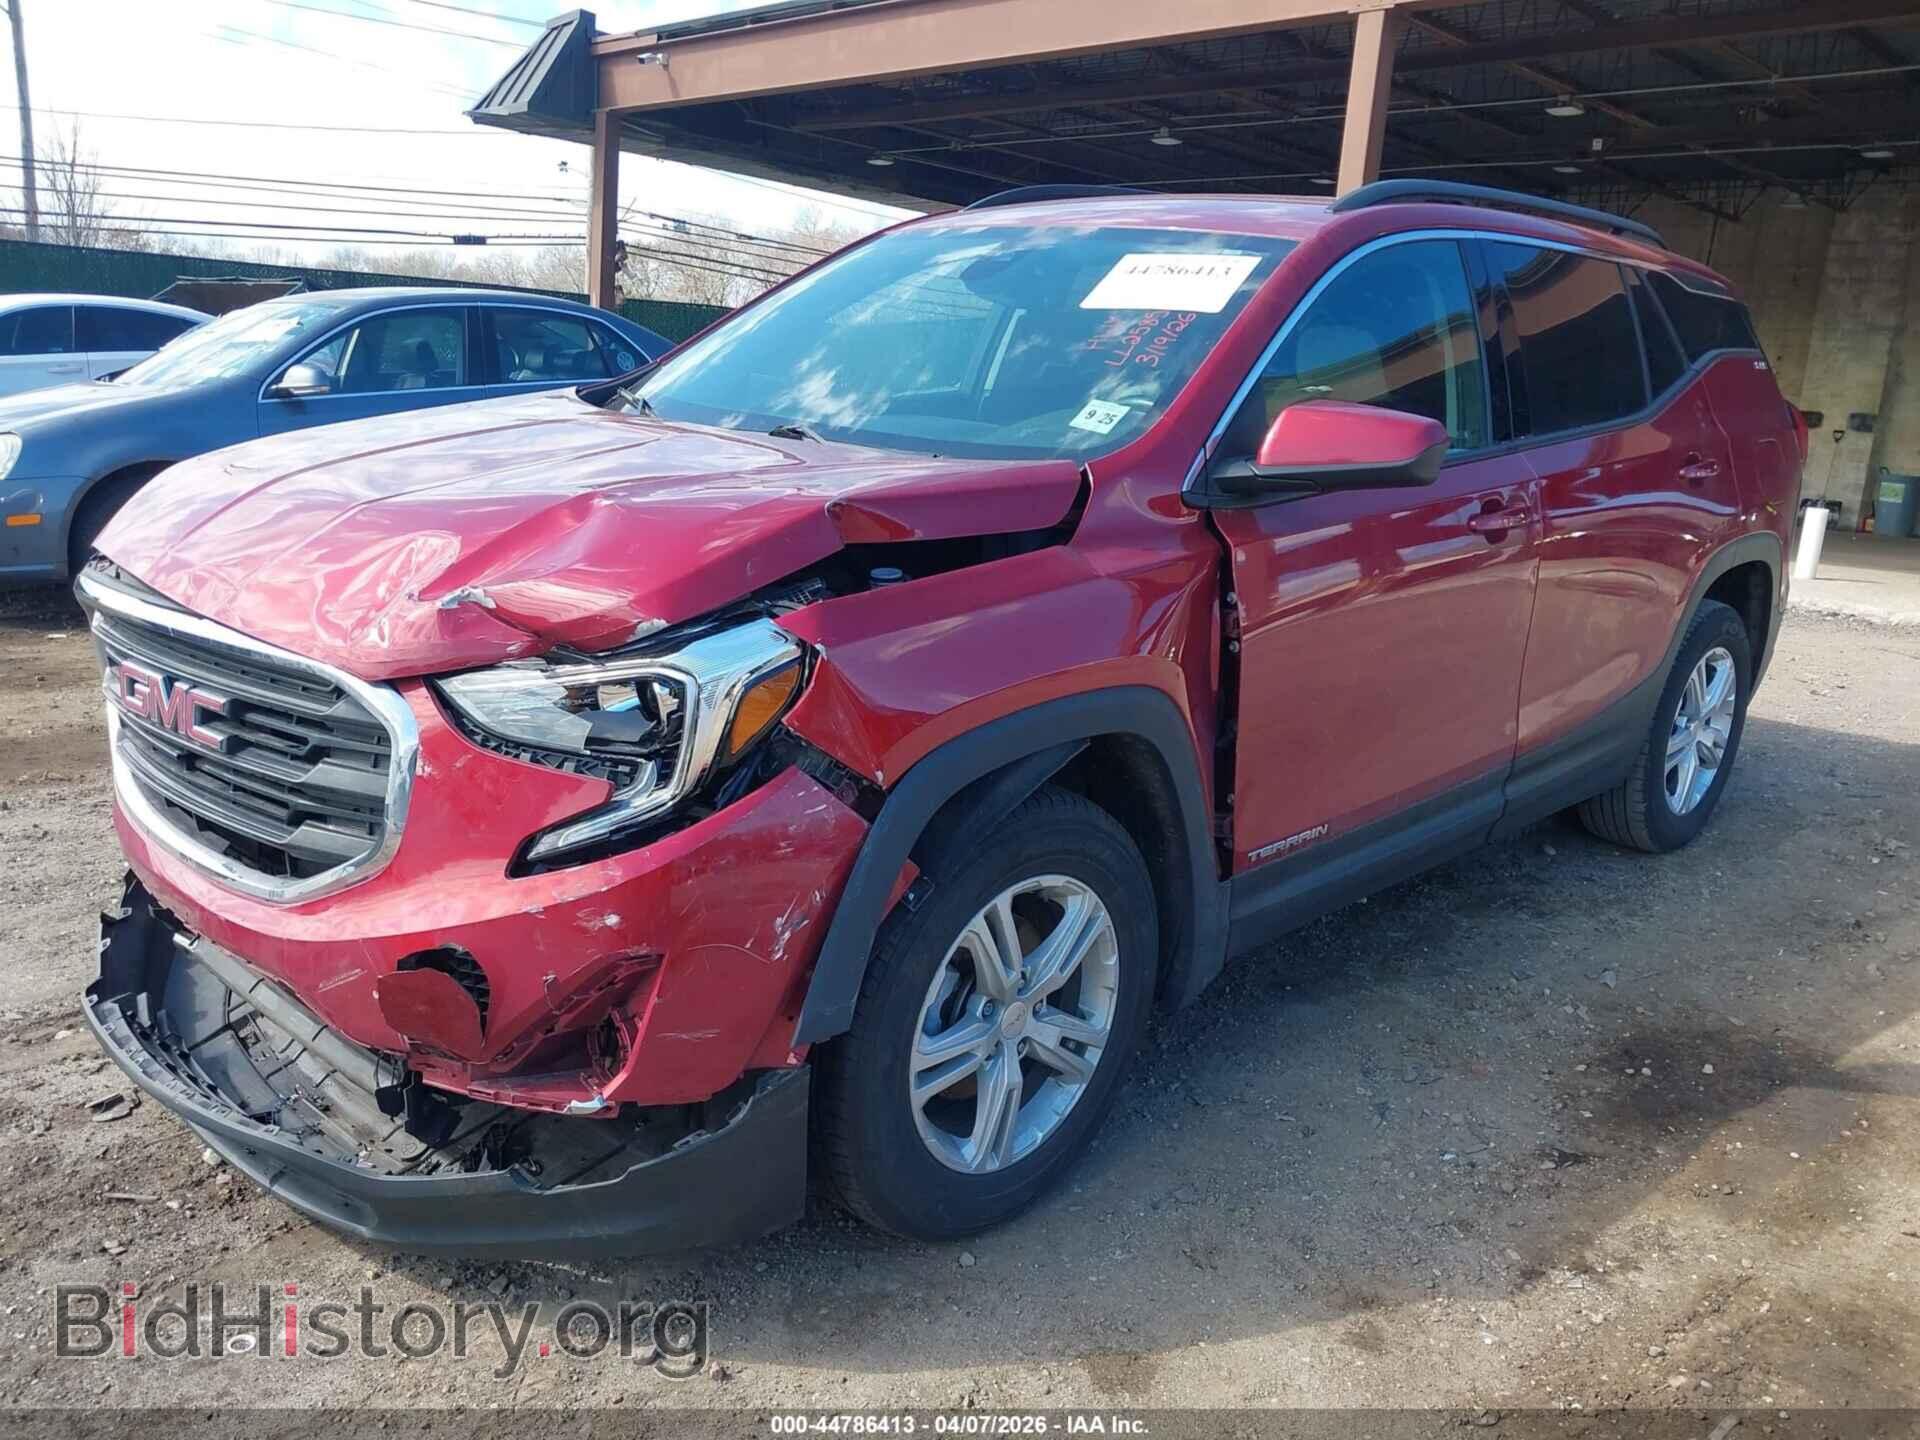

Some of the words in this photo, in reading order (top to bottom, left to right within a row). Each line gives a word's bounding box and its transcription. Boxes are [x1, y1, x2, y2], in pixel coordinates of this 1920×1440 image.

[1135, 312, 1196, 368] 3/19/26
[1085, 409, 1097, 420] 9
[1098, 412, 1119, 425] 25
[118, 660, 226, 752] GMC
[1246, 823, 1329, 862] TERRAIN
